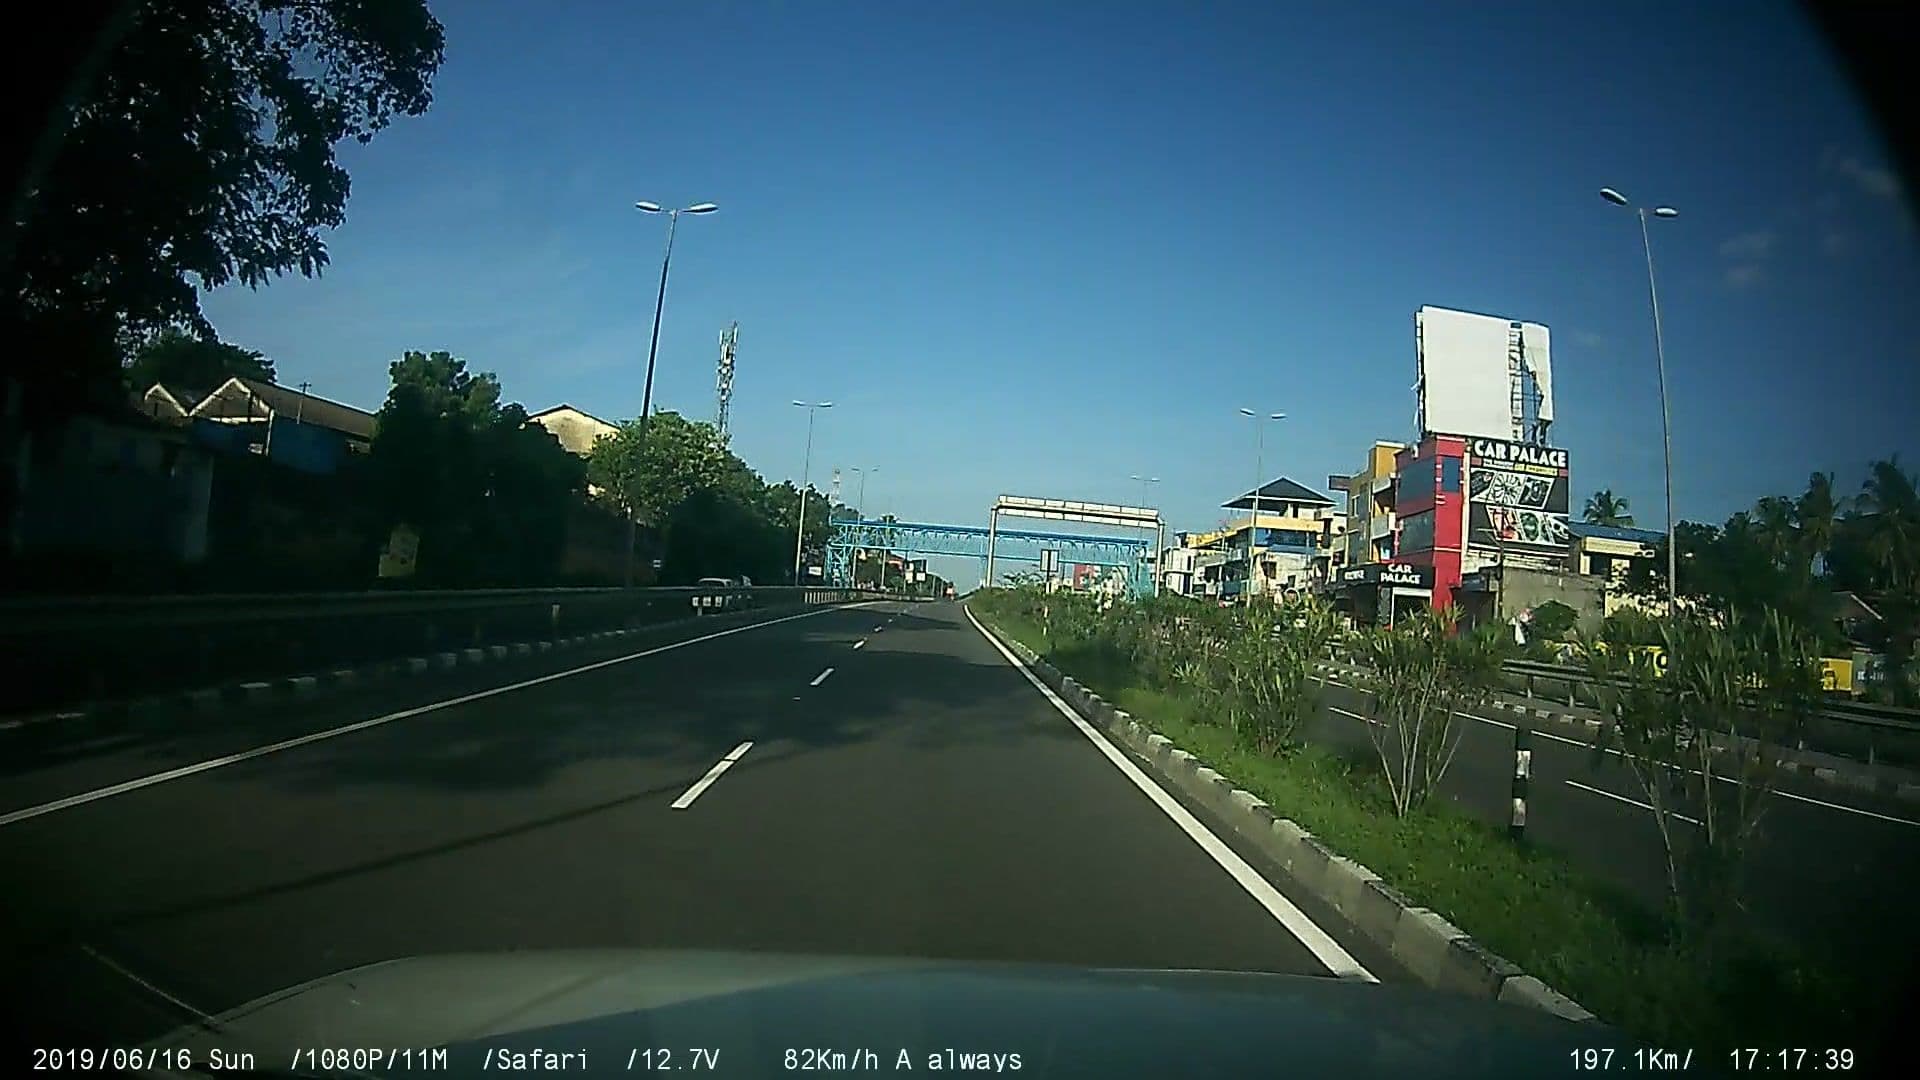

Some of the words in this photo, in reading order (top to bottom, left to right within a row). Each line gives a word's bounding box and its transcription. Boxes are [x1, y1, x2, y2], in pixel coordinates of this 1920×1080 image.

[1474, 440, 1507, 460] CAR
[1509, 445, 1567, 467] PALACE
[1387, 563, 1413, 574] CAR
[1380, 572, 1421, 585] PALACE
